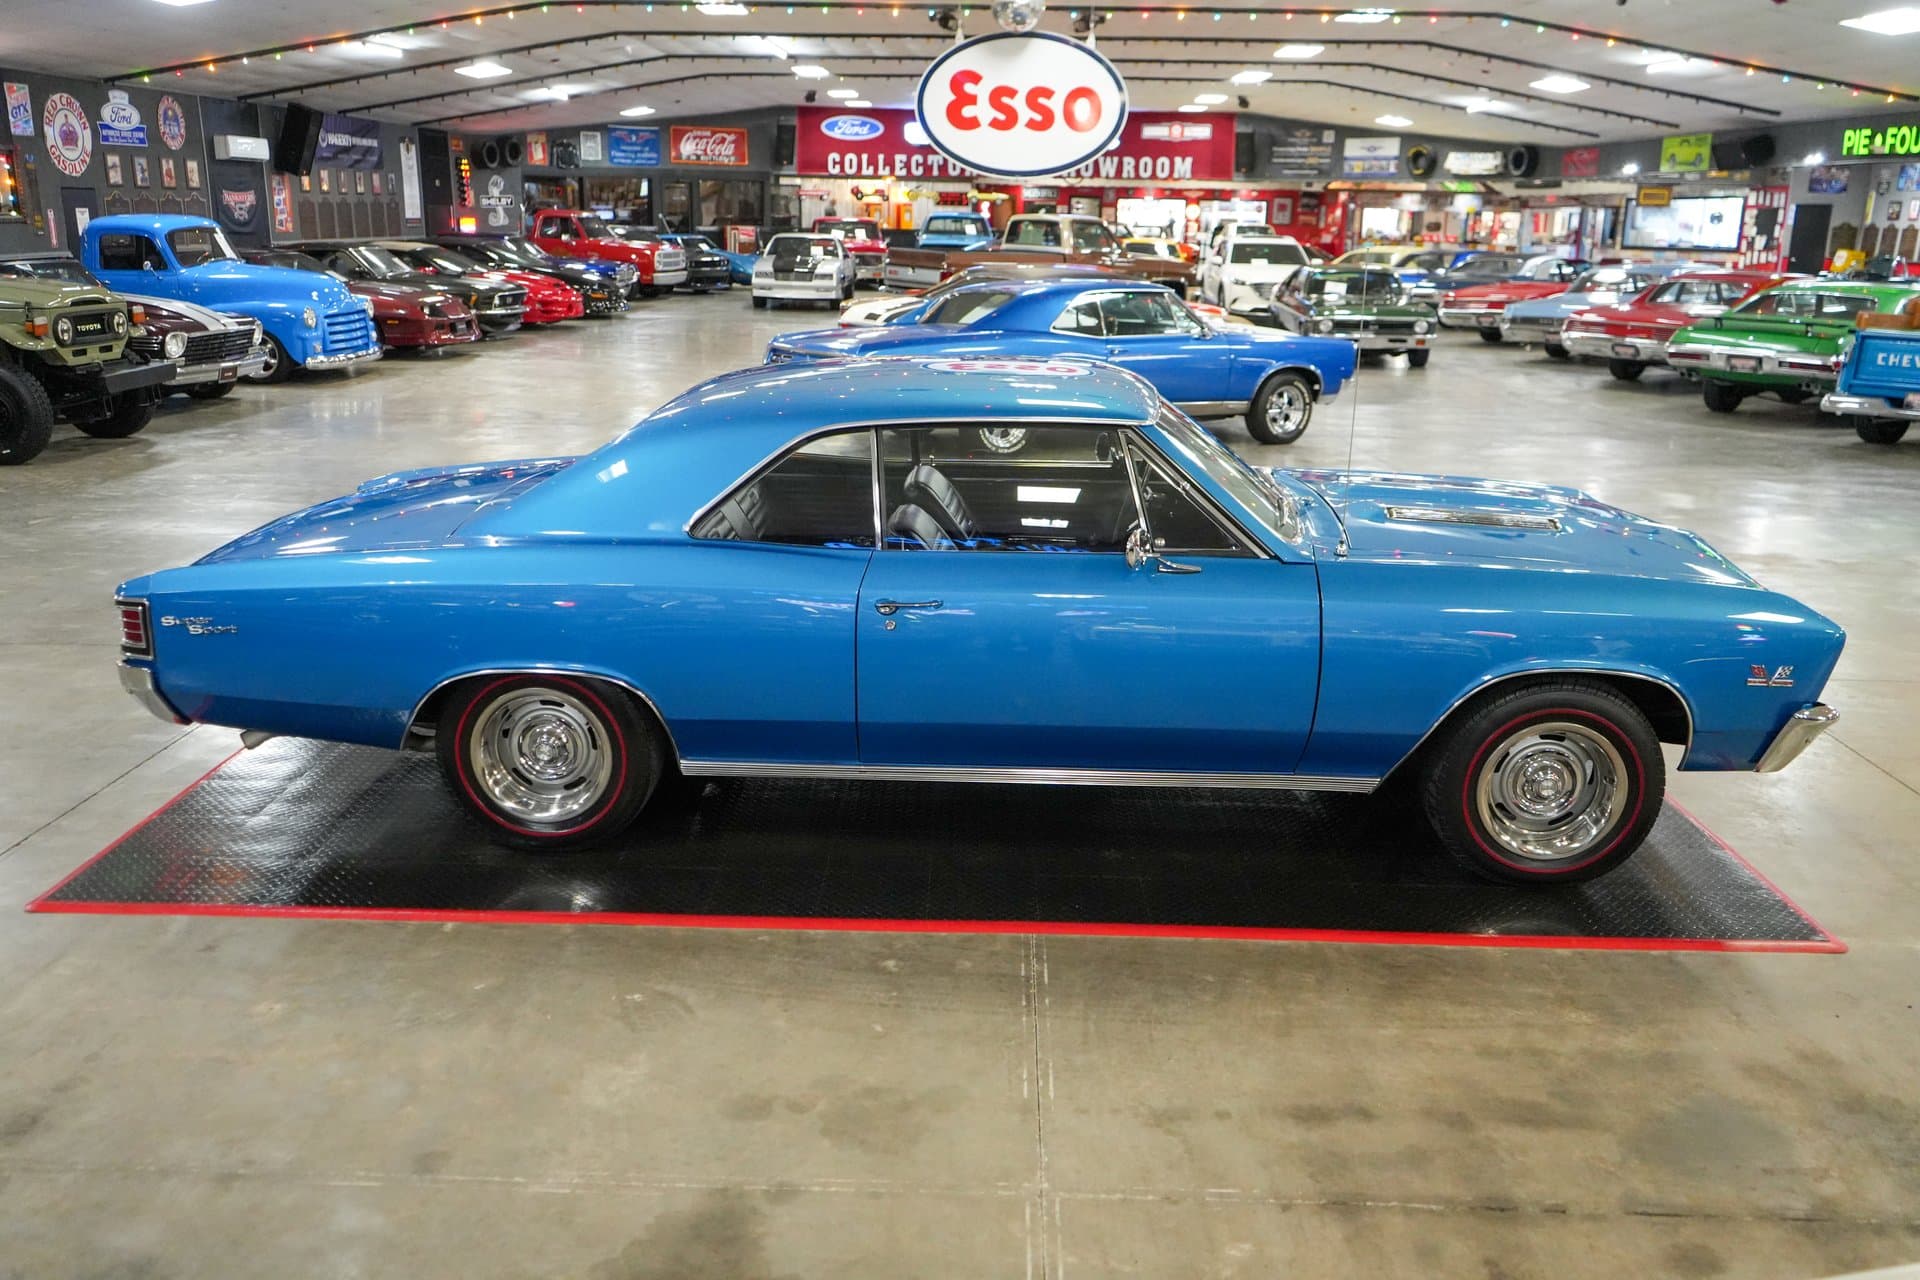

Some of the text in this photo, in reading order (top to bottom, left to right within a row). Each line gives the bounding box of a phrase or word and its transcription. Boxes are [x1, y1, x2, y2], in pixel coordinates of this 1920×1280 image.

[11, 102, 29, 119] GTX
[946, 69, 1102, 133] Esso
[45, 95, 88, 131] RED CROWN
[110, 107, 133, 125] Ford
[834, 119, 871, 136] Ford
[680, 132, 736, 156] Coca-Cola
[1842, 128, 1872, 156] PIE
[50, 144, 91, 174] GASOLINE
[1062, 156, 1194, 178] OWROOM
[77, 323, 102, 331] TOYOTA
[160, 615, 213, 626] Super
[189, 624, 237, 635] Sport
